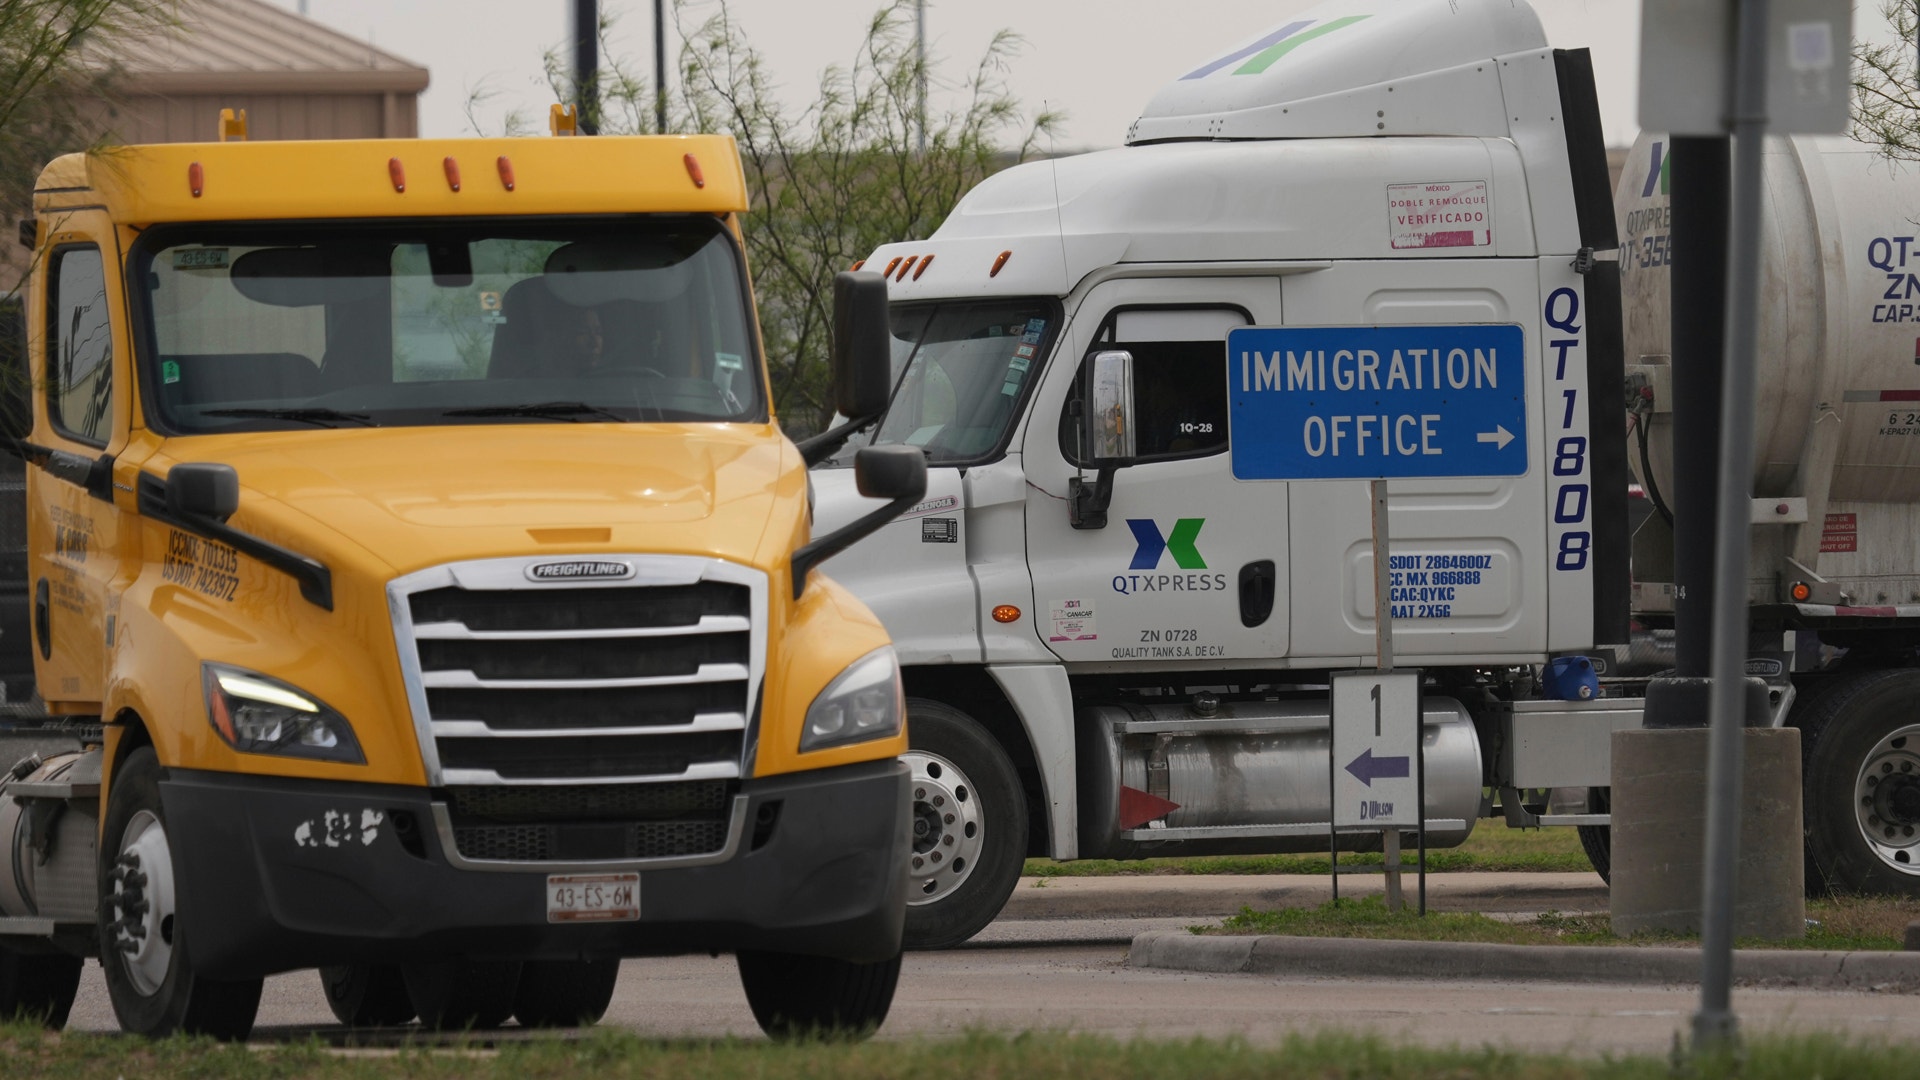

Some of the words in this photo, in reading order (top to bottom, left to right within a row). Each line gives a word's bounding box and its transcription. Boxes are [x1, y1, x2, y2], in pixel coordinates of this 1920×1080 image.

[1425, 184, 1450, 192] MÉXICO
[1391, 199, 1424, 208] DOBLE
[1429, 196, 1486, 207] REMOLQUE
[1398, 211, 1484, 225] VERIFICADO
[1627, 206, 1670, 236] QTXPRE
[1241, 348, 1498, 392] IMMIGRATION
[1180, 422, 1213, 433] 10-28
[1303, 414, 1443, 457] OFFICE
[202, 540, 238, 574] 701315
[1390, 555, 1422, 570] SDOT
[1425, 555, 1492, 570] 2864600Z
[536, 563, 625, 577] FREIGHTLINER
[1112, 574, 1227, 595] QTXPRESS
[1389, 572, 1403, 586] CC
[1406, 572, 1429, 586] MX
[1432, 571, 1481, 585] 966888
[1390, 587, 1455, 603] CAC:QYKC
[1064, 600, 1080, 608] 2021
[1391, 605, 1415, 619] AAT
[1140, 630, 1160, 642] ZN
[1165, 629, 1198, 642] 0728
[1112, 647, 1150, 659] QUALITY
[1152, 646, 1175, 658] TANK
[1176, 646, 1193, 657] S.A.
[1195, 646, 1209, 657] DE
[1209, 645, 1225, 657] C.V.
[1370, 683, 1382, 737] 1
[555, 885, 632, 908] 43-ES-6W
